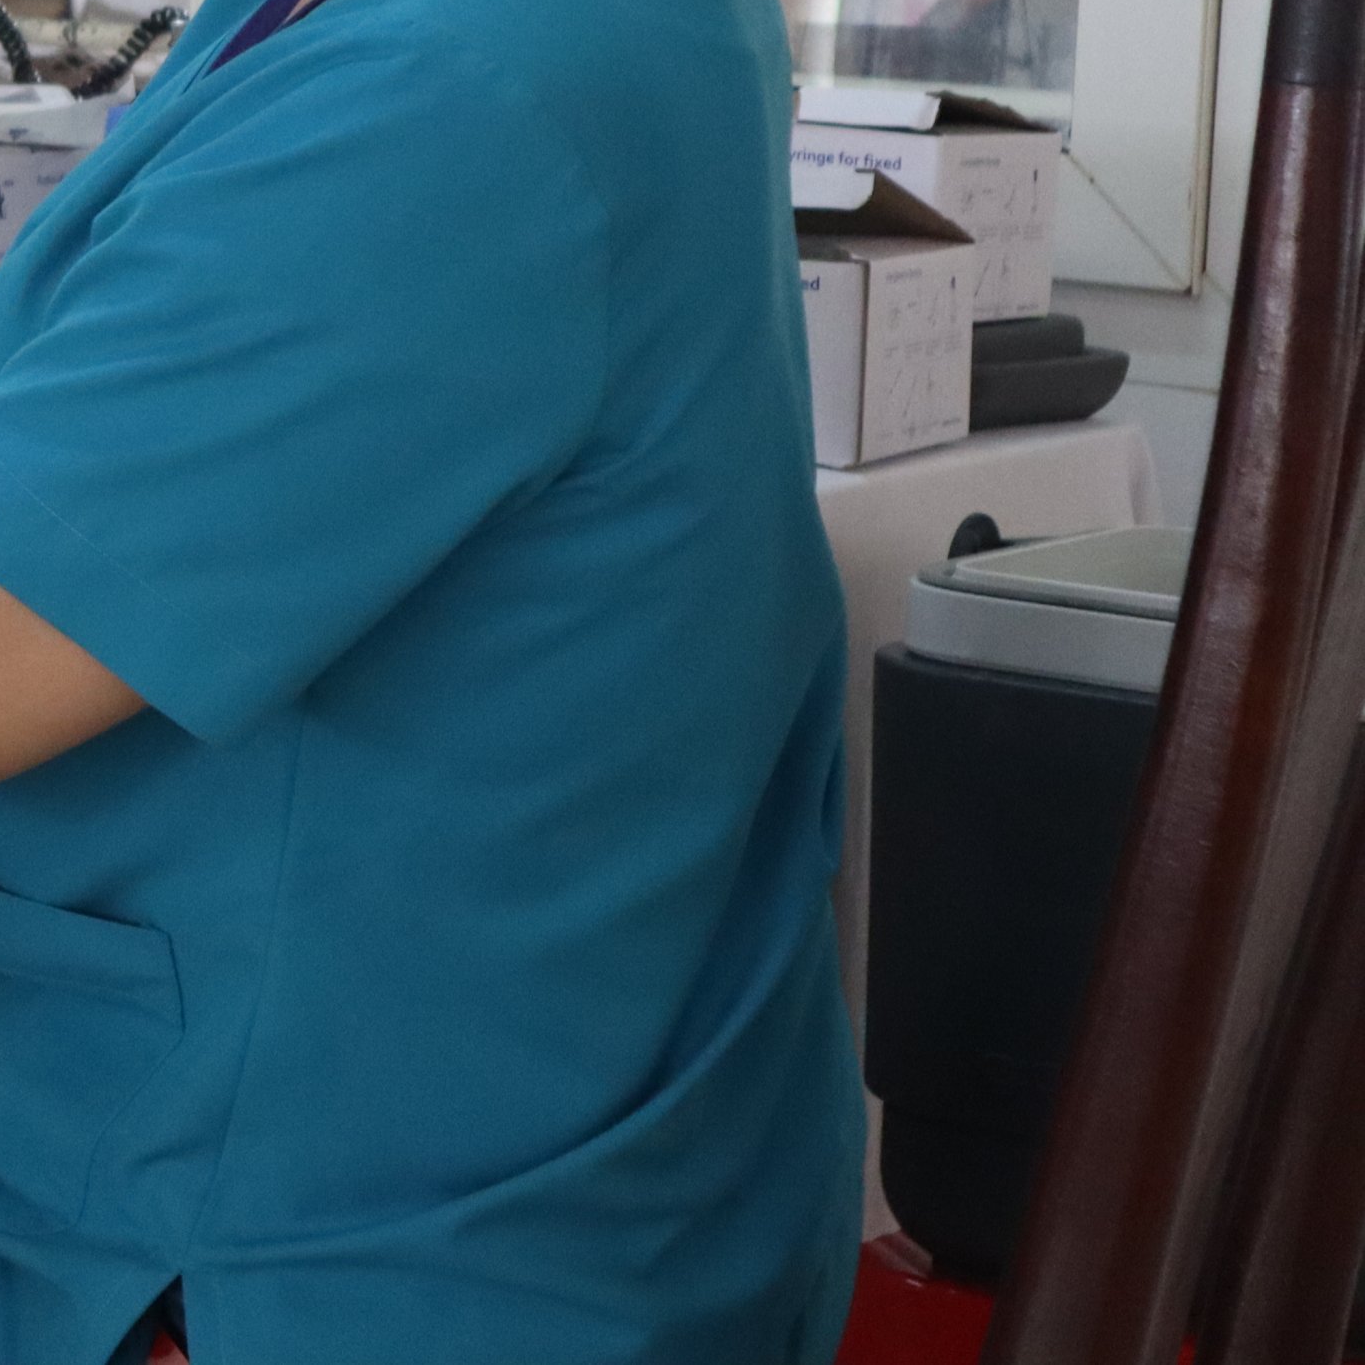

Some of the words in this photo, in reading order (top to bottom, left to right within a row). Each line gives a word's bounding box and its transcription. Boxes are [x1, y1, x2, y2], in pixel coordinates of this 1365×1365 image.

[790, 148, 835, 167] yringe
[839, 151, 858, 167] for
[864, 152, 902, 171] fixed
